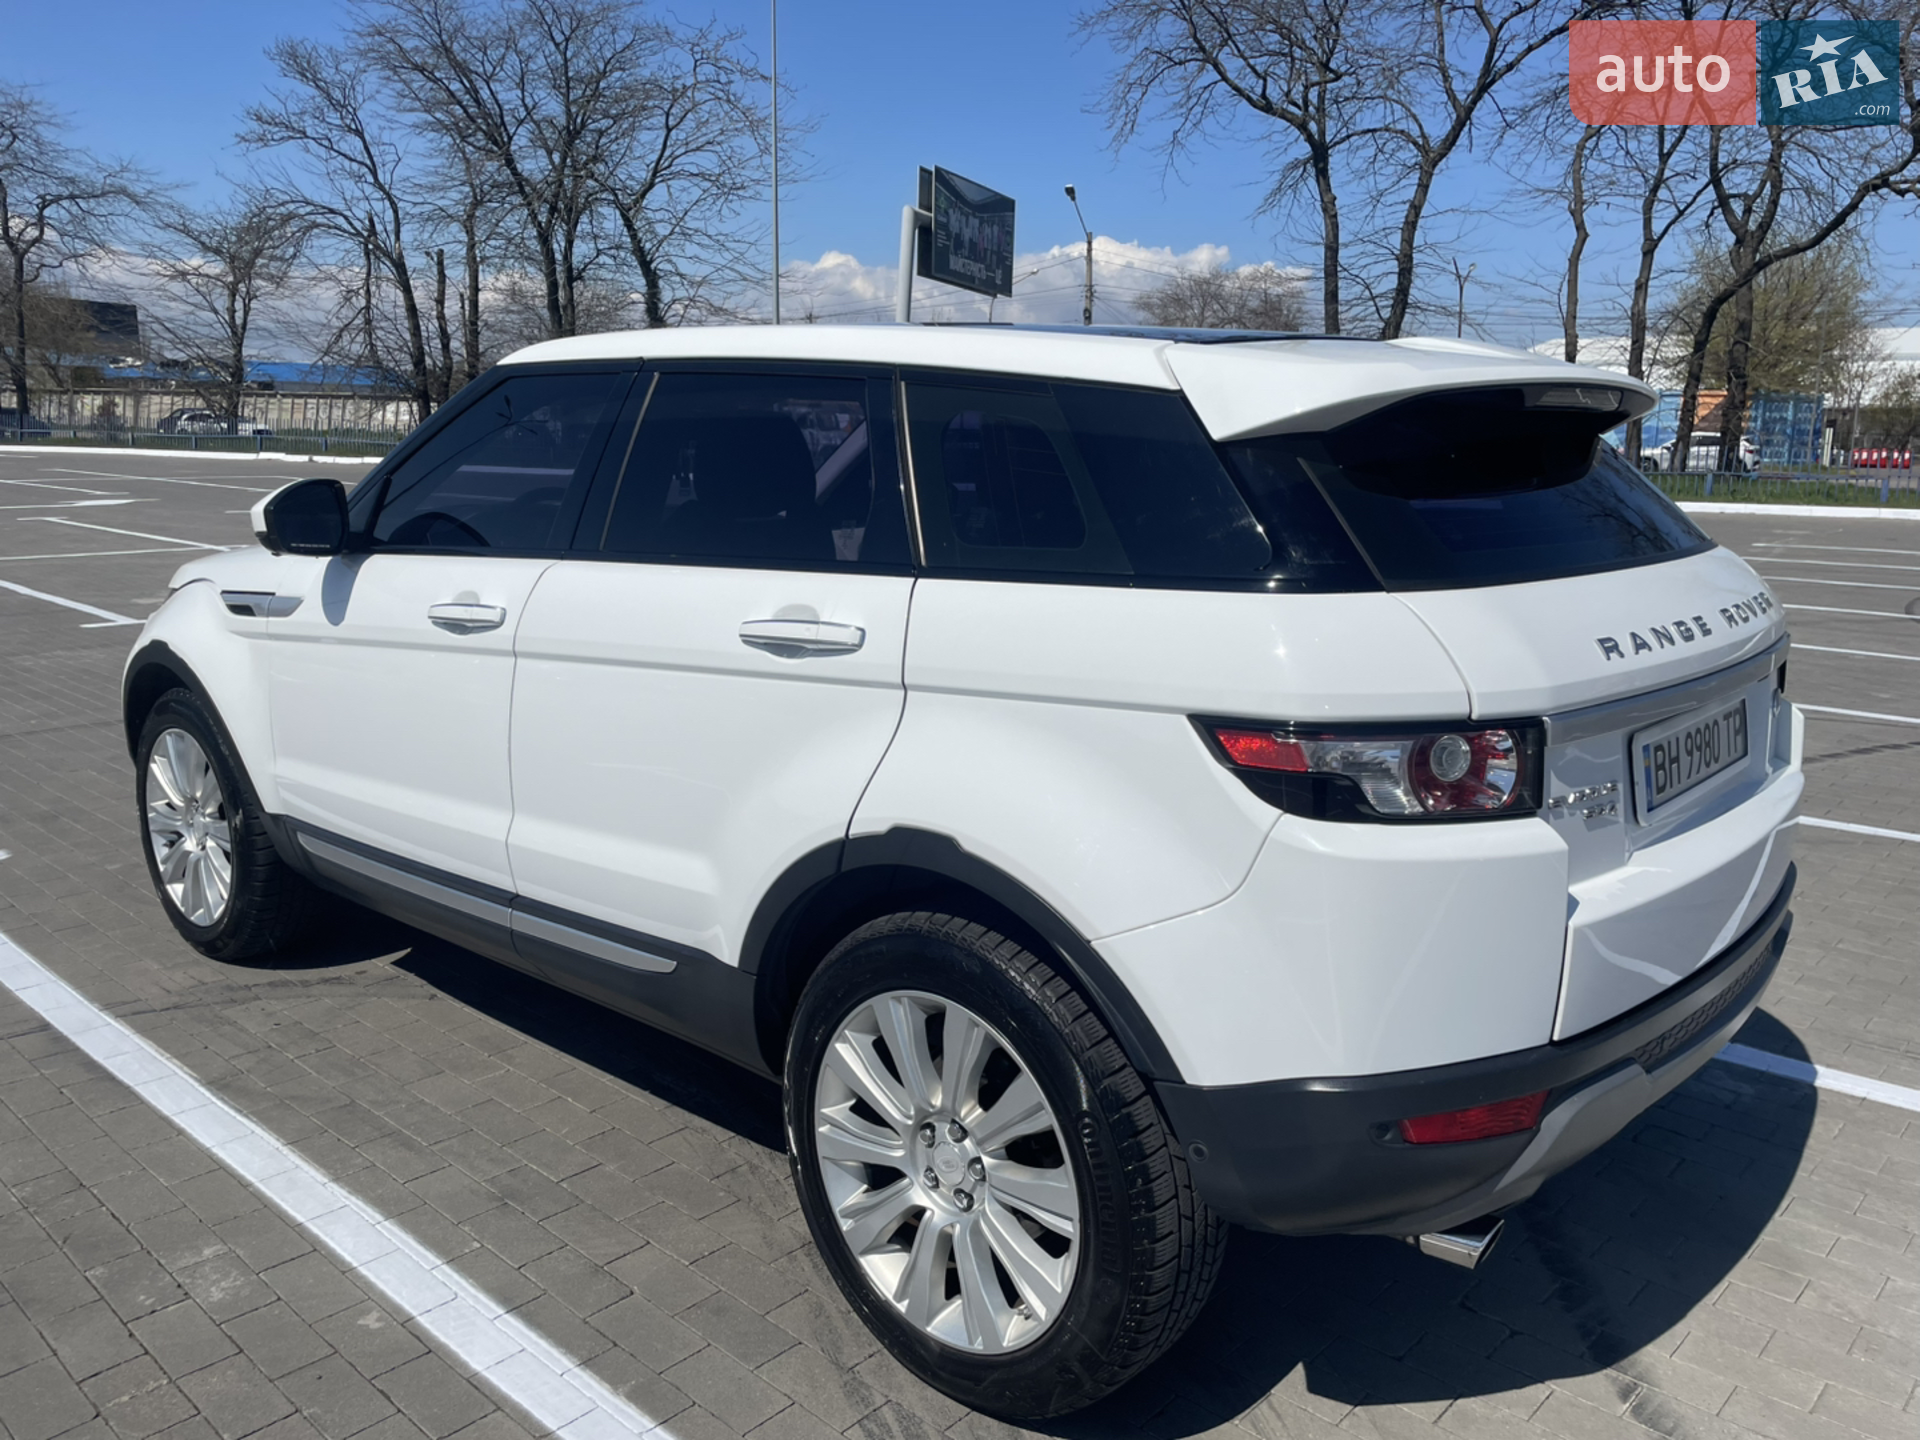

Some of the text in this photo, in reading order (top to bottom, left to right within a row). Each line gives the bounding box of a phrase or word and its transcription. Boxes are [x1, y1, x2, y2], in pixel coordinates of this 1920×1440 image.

[1597, 592, 1773, 661] RANGE ROVER
[1684, 718, 1721, 780] 9980
[1723, 708, 1743, 758] TP
